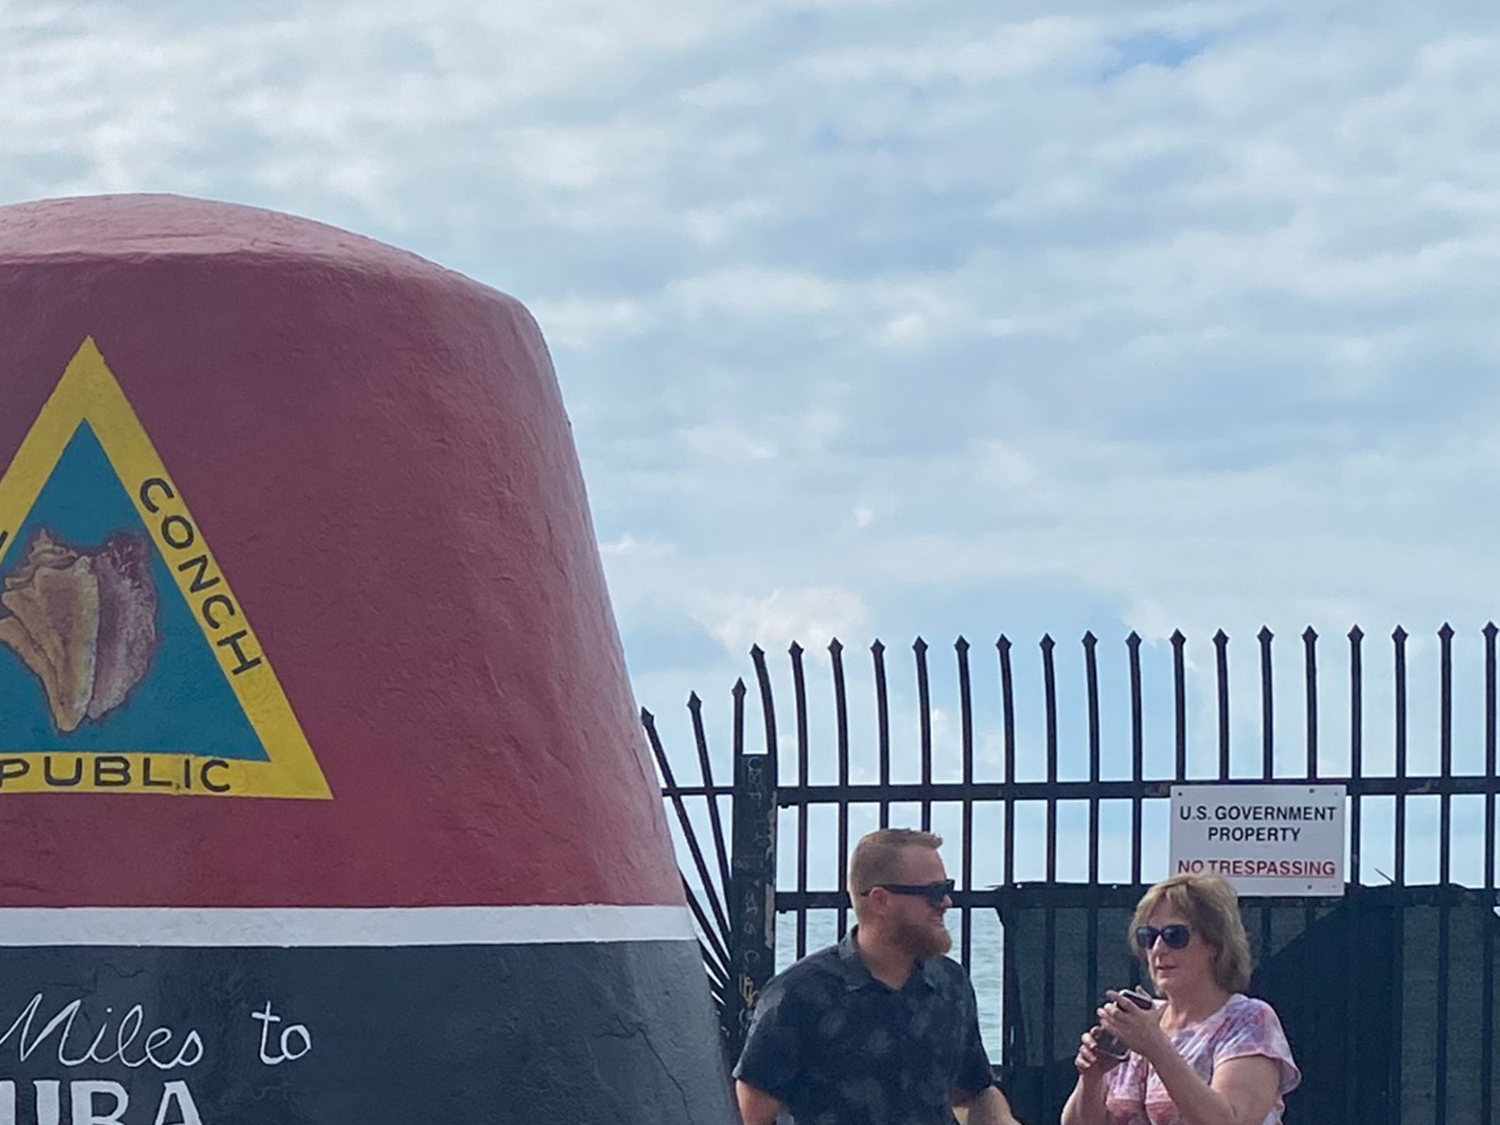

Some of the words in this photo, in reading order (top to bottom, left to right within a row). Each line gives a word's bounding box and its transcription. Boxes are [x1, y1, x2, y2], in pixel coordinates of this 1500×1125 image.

[139, 477, 263, 677] CONCH
[1179, 806, 1211, 821] U.S.
[1214, 806, 1337, 821] GOVERNMENT
[1207, 827, 1301, 842] PROPERTY
[1177, 860, 1204, 874] NO
[1209, 860, 1336, 876] TRESPASSING
[251, 1001, 312, 1065] to
